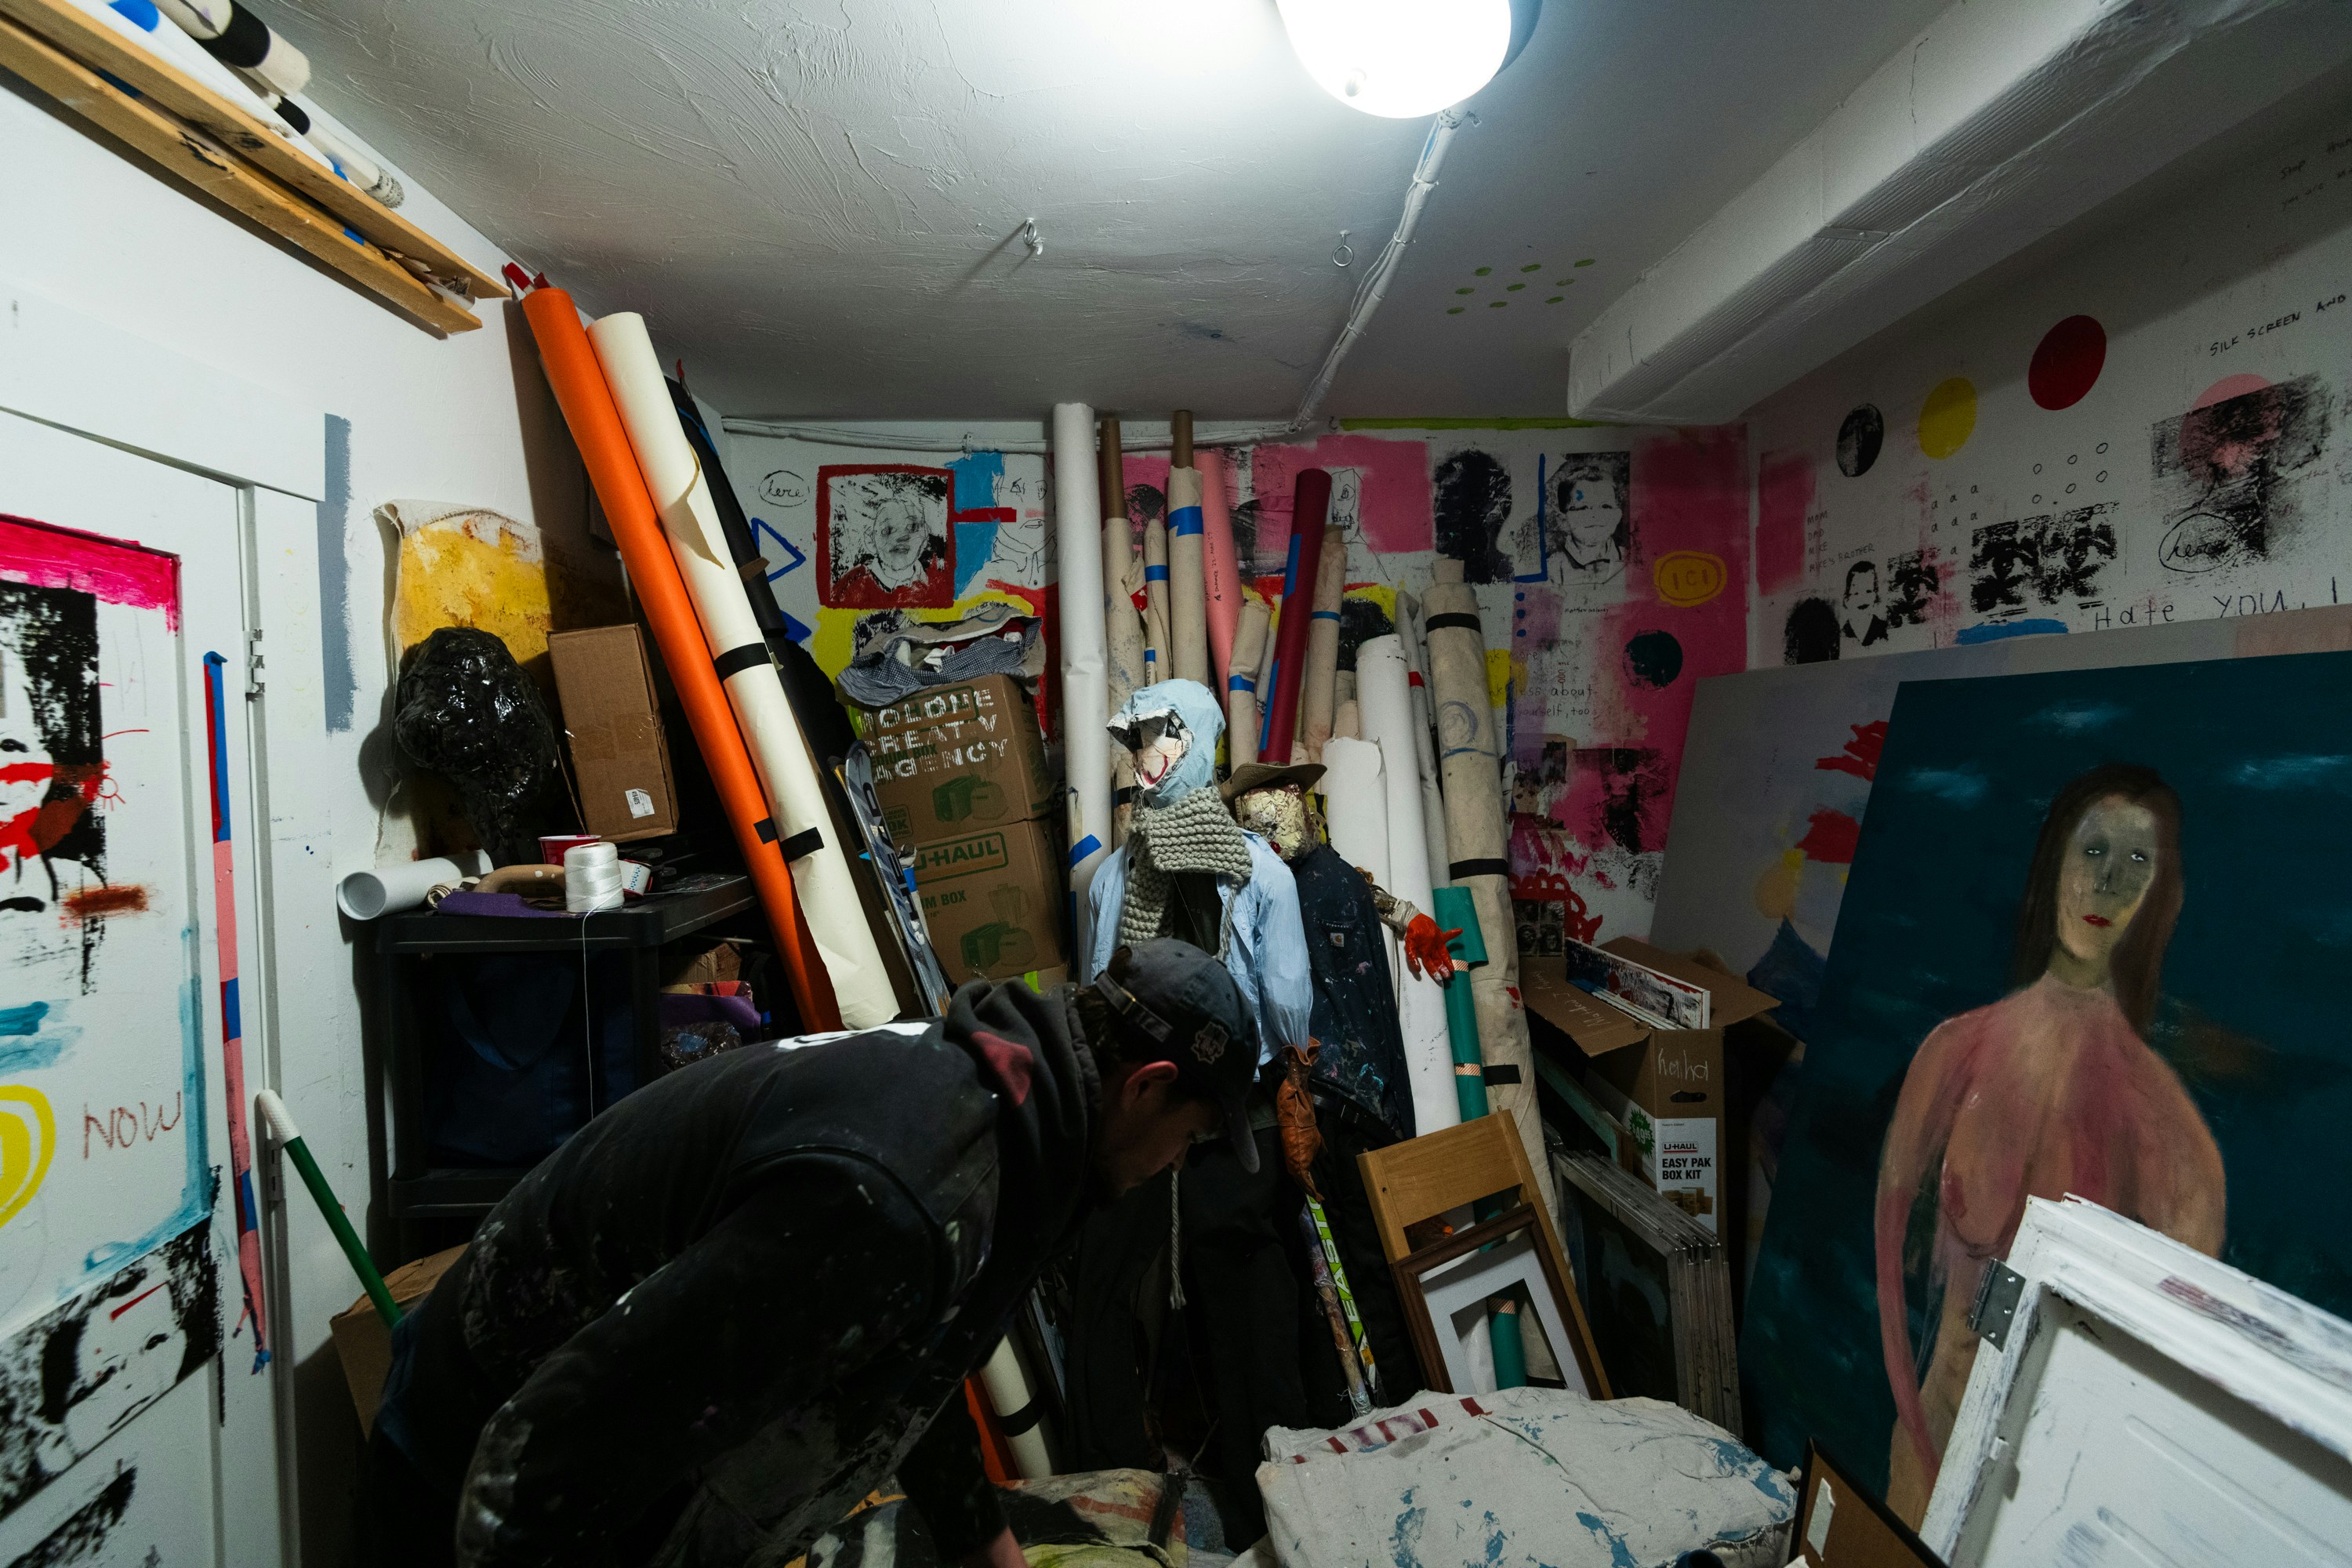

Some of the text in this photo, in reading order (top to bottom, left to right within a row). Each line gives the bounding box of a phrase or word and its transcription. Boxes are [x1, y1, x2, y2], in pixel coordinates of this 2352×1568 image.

[2209, 293, 2347, 356] SILK SCREEN AND
[764, 479, 805, 497] here
[2095, 599, 2175, 631] Hate
[1551, 684, 1593, 697] about
[940, 889, 968, 906] BOX
[1657, 1047, 1709, 1082] haha
[83, 1091, 181, 1160] NOW
[1662, 1157, 1711, 1168] EASY PAK
[1662, 1170, 1702, 1180] BOX KIT
